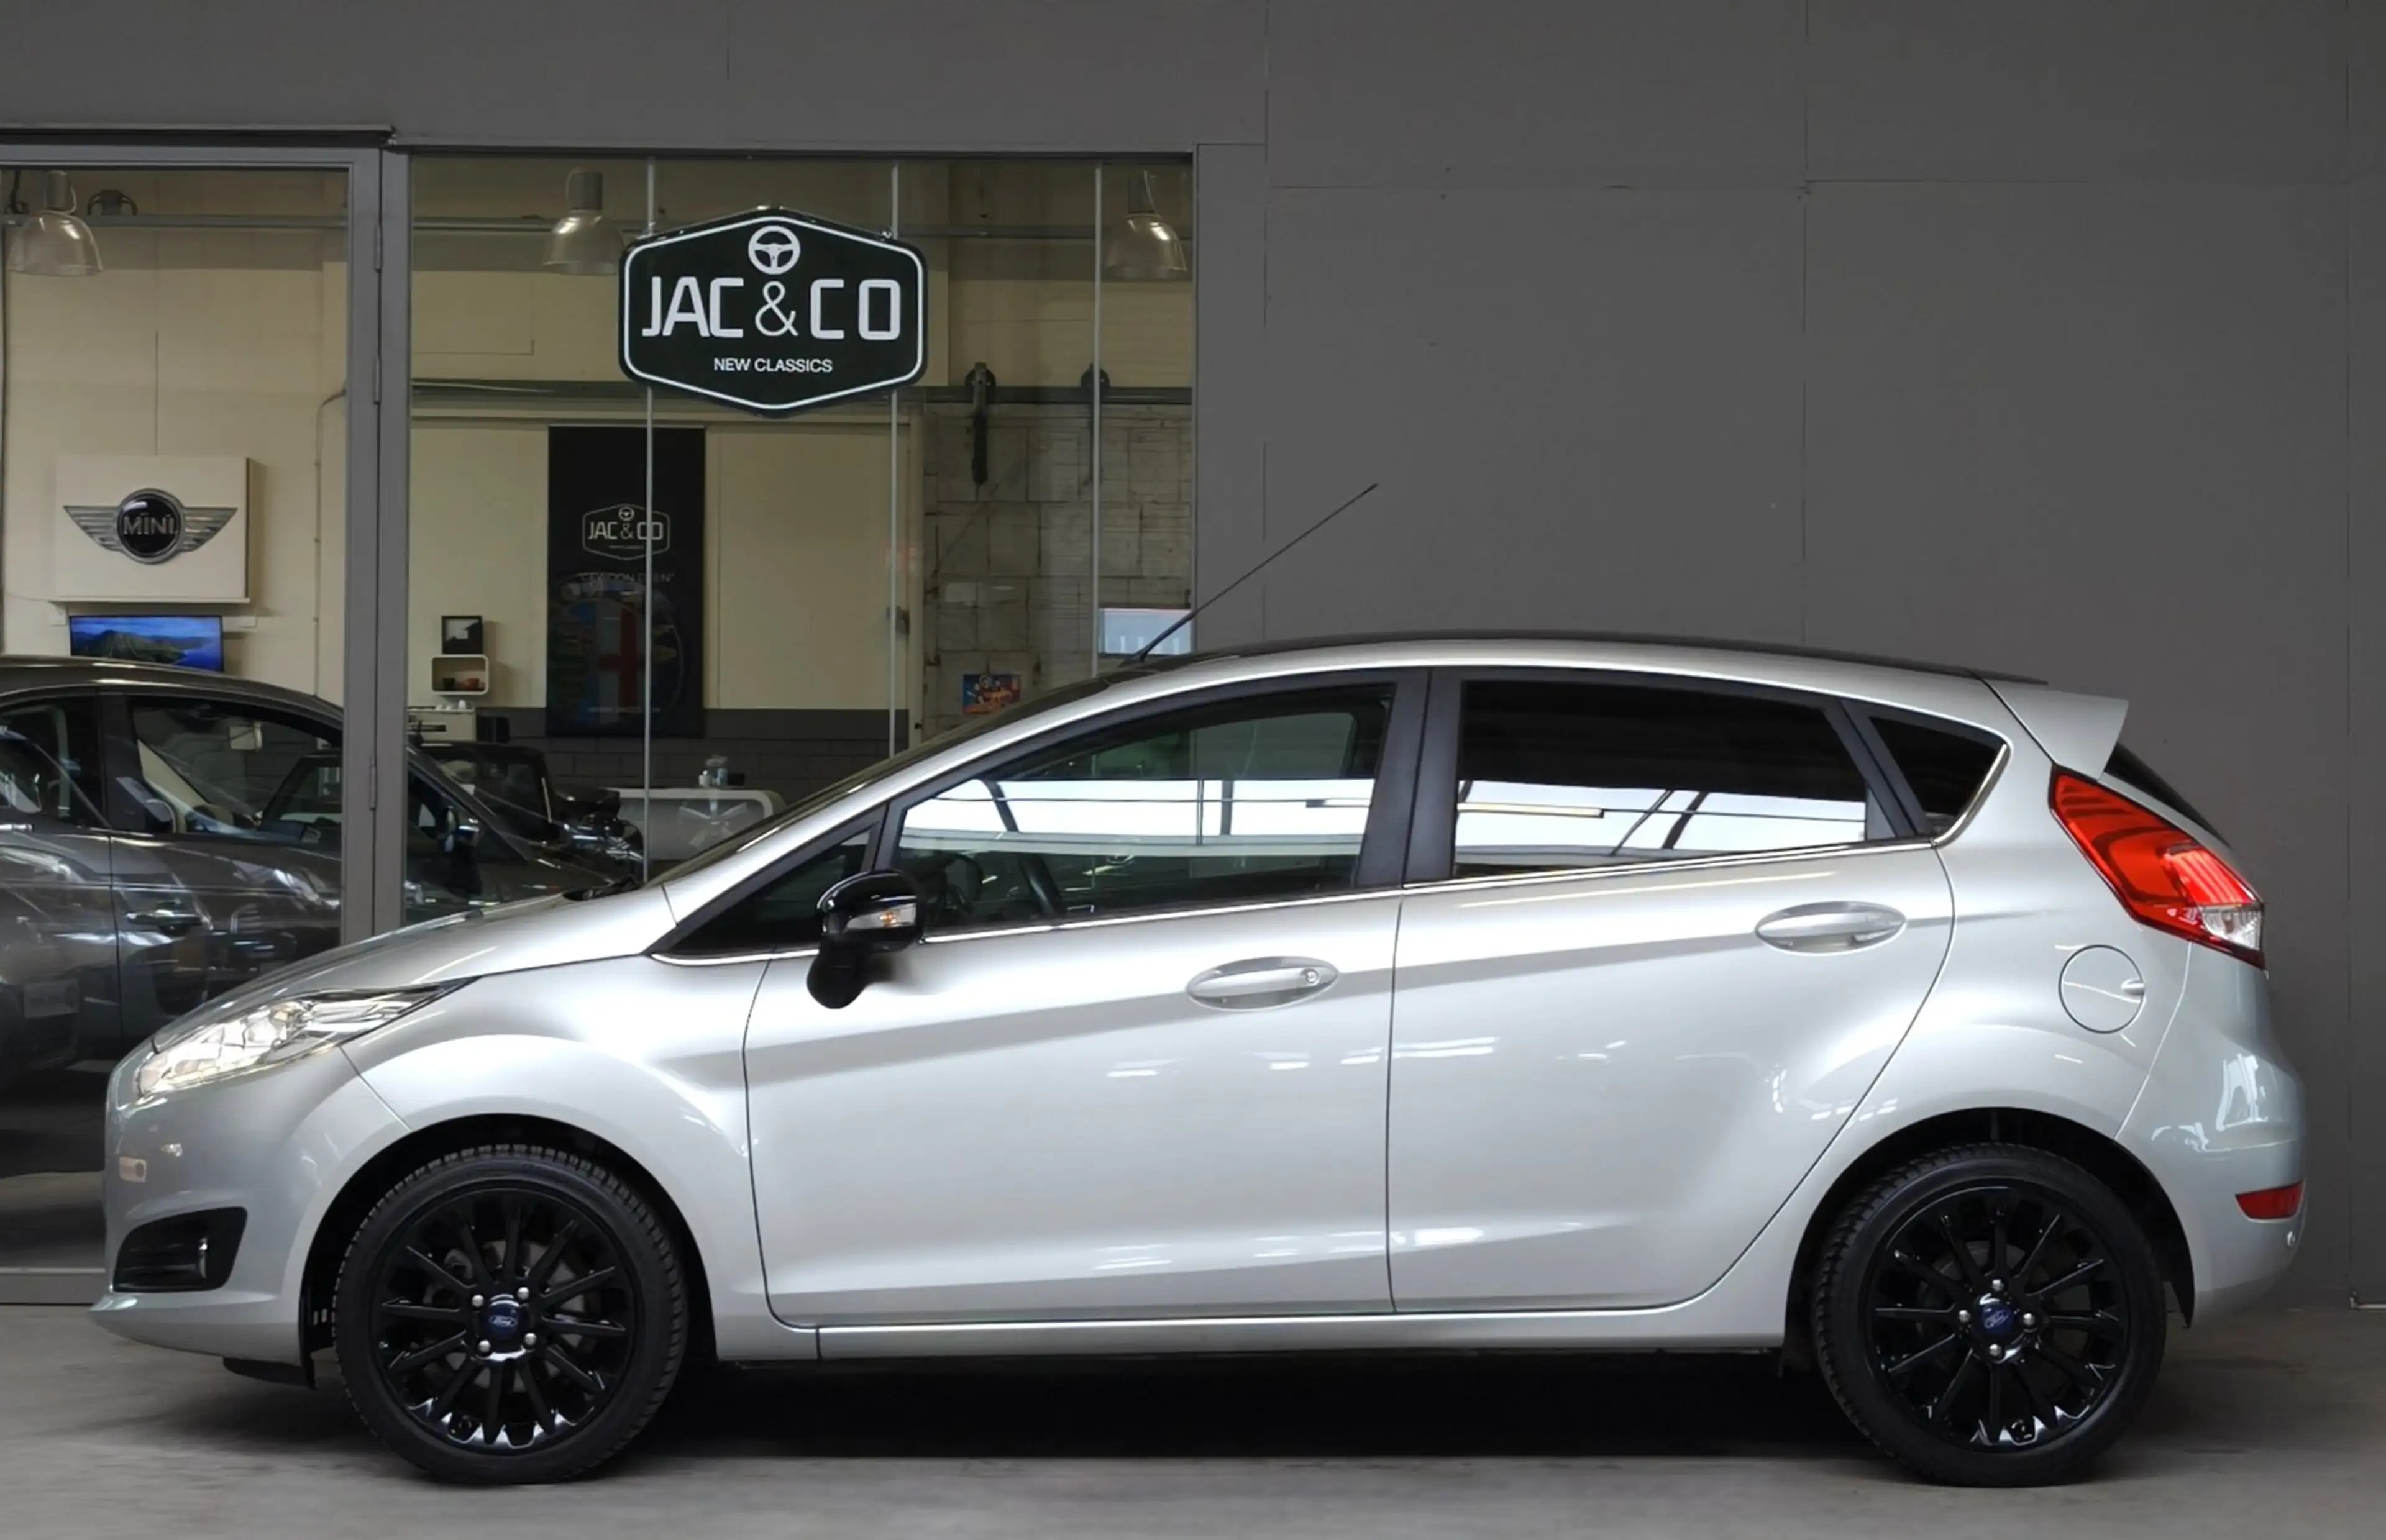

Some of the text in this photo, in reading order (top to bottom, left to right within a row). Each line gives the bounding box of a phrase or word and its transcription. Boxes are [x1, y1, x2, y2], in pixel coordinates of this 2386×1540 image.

[714, 357, 833, 373] NEW CLASSICS
[123, 512, 178, 535] MINI
